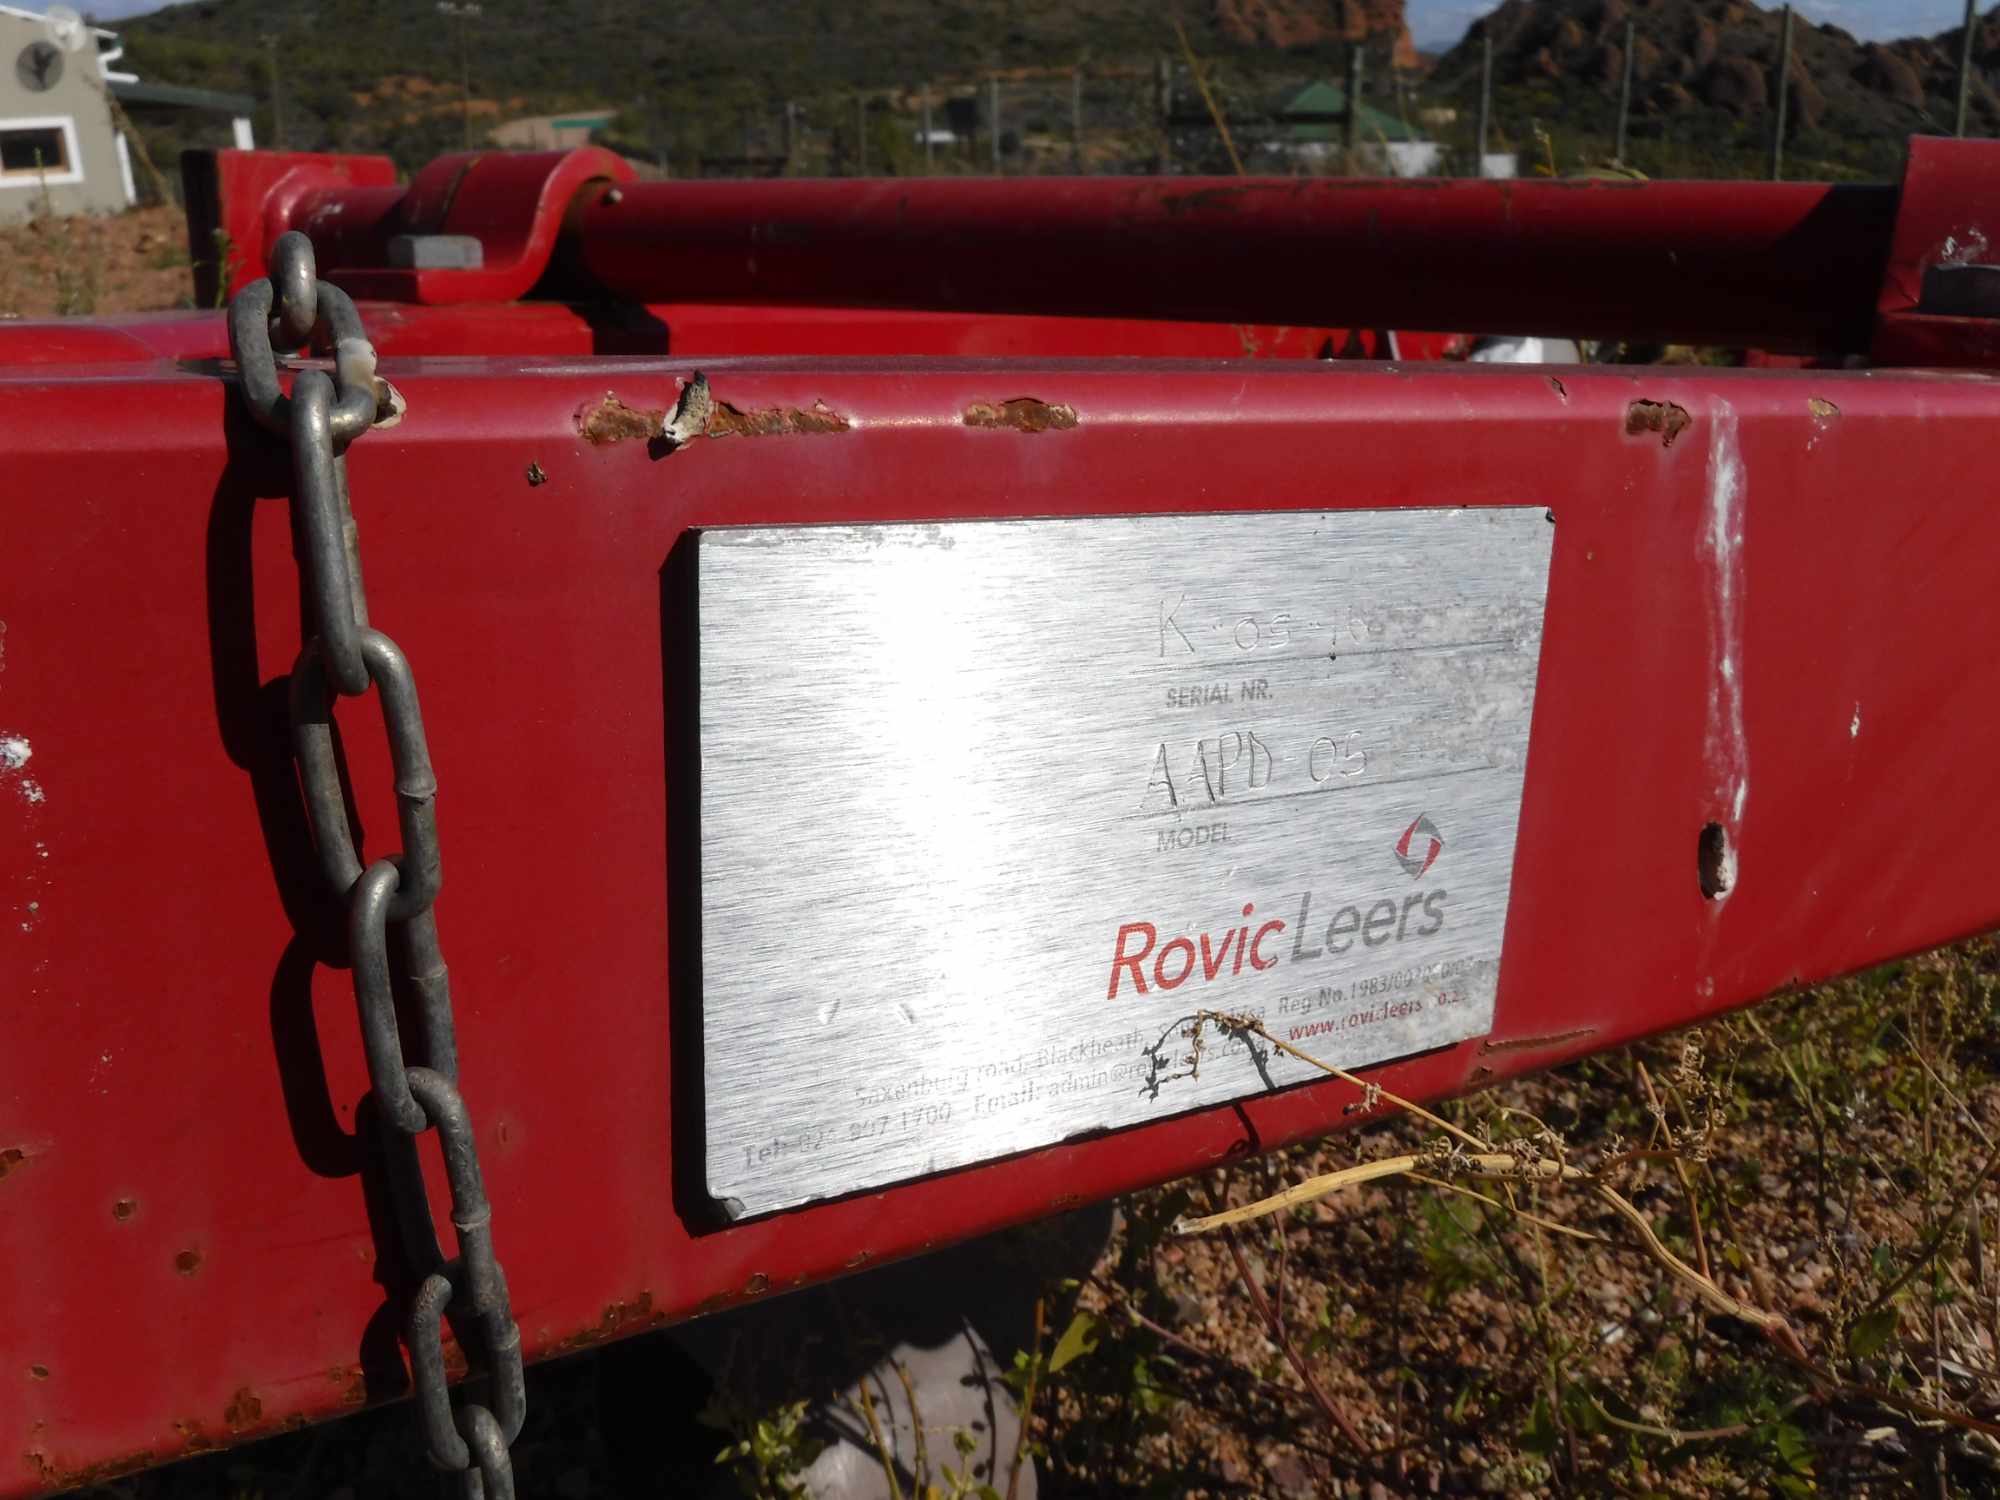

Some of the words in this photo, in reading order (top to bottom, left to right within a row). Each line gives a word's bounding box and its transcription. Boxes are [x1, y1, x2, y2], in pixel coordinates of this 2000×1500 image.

[1166, 682, 1233, 708] SERIAL
[1241, 678, 1273, 701] NR.
[1156, 822, 1230, 852] MODEL
